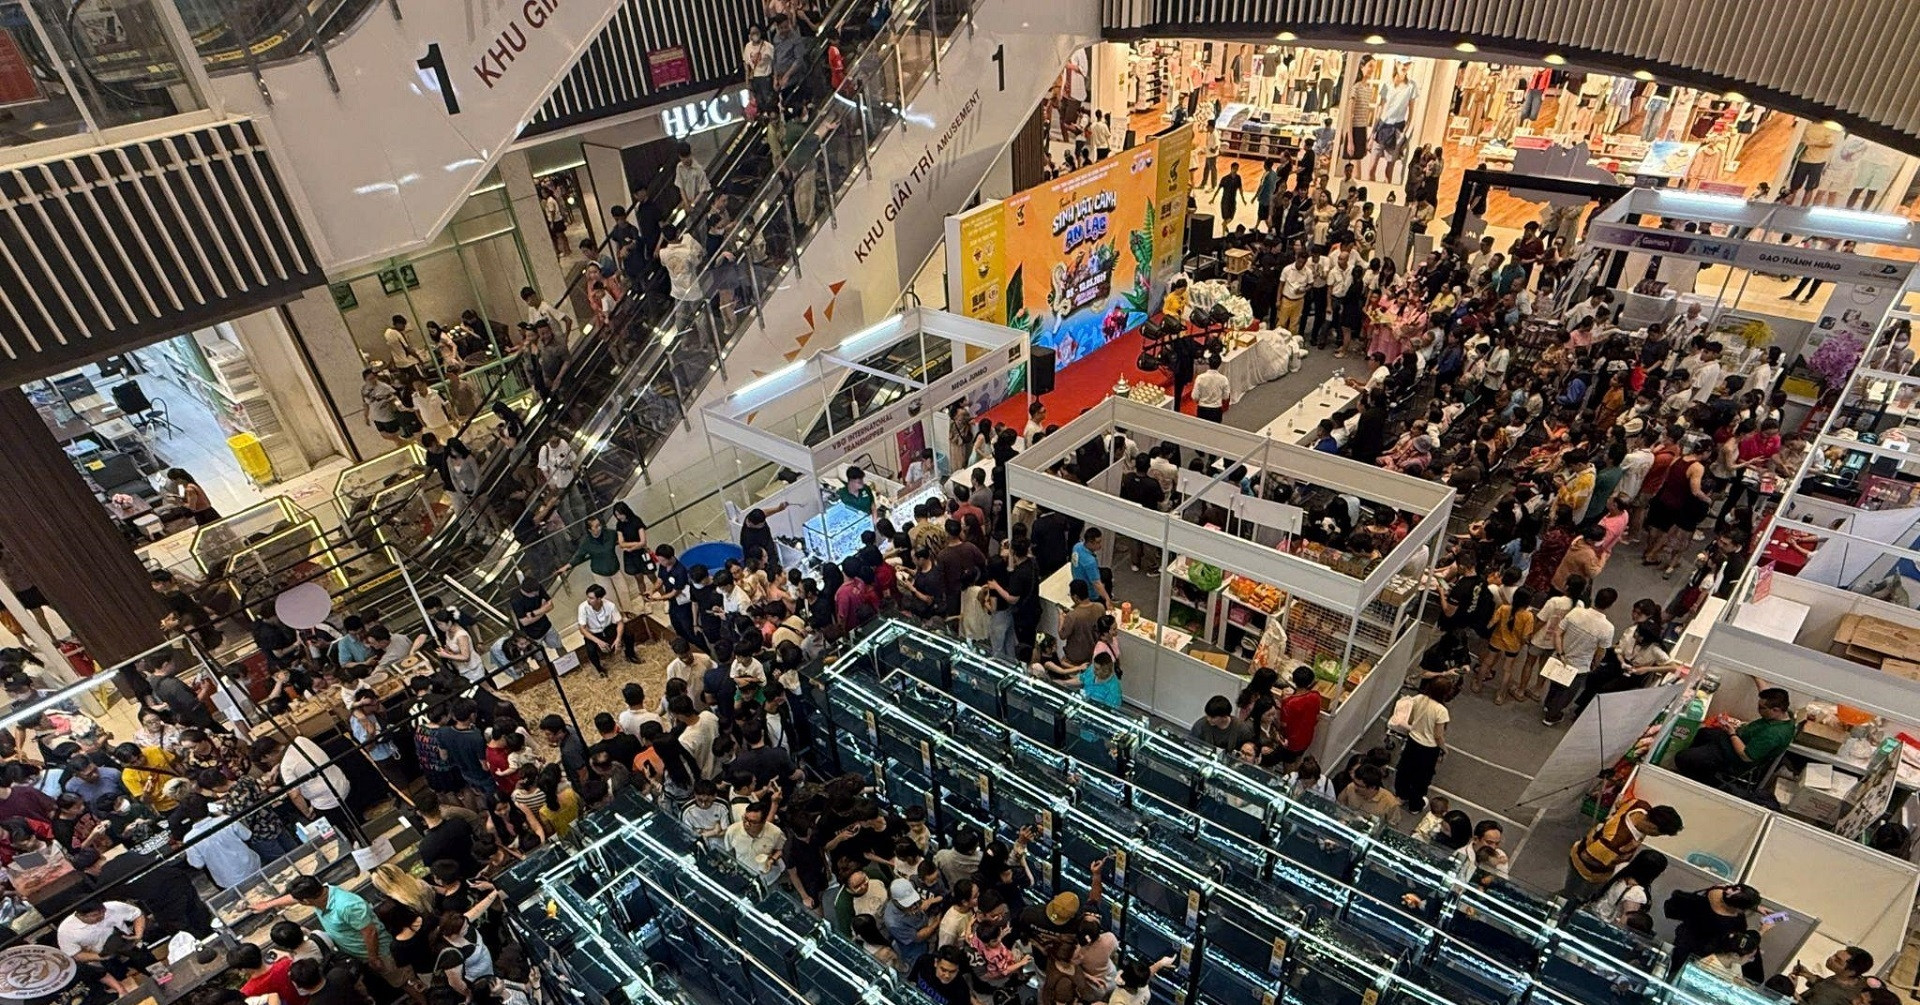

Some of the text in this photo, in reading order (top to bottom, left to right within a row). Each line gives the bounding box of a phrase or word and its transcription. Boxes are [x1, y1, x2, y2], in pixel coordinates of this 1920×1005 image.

[473, 0, 558, 89] KHU GI
[991, 44, 1005, 91] 1
[416, 43, 461, 115] 1
[854, 88, 981, 264] KHU GIẢI TRÍ AMUSEMENT
[1052, 205, 1075, 235] SINH
[966, 951, 987, 967] 25
